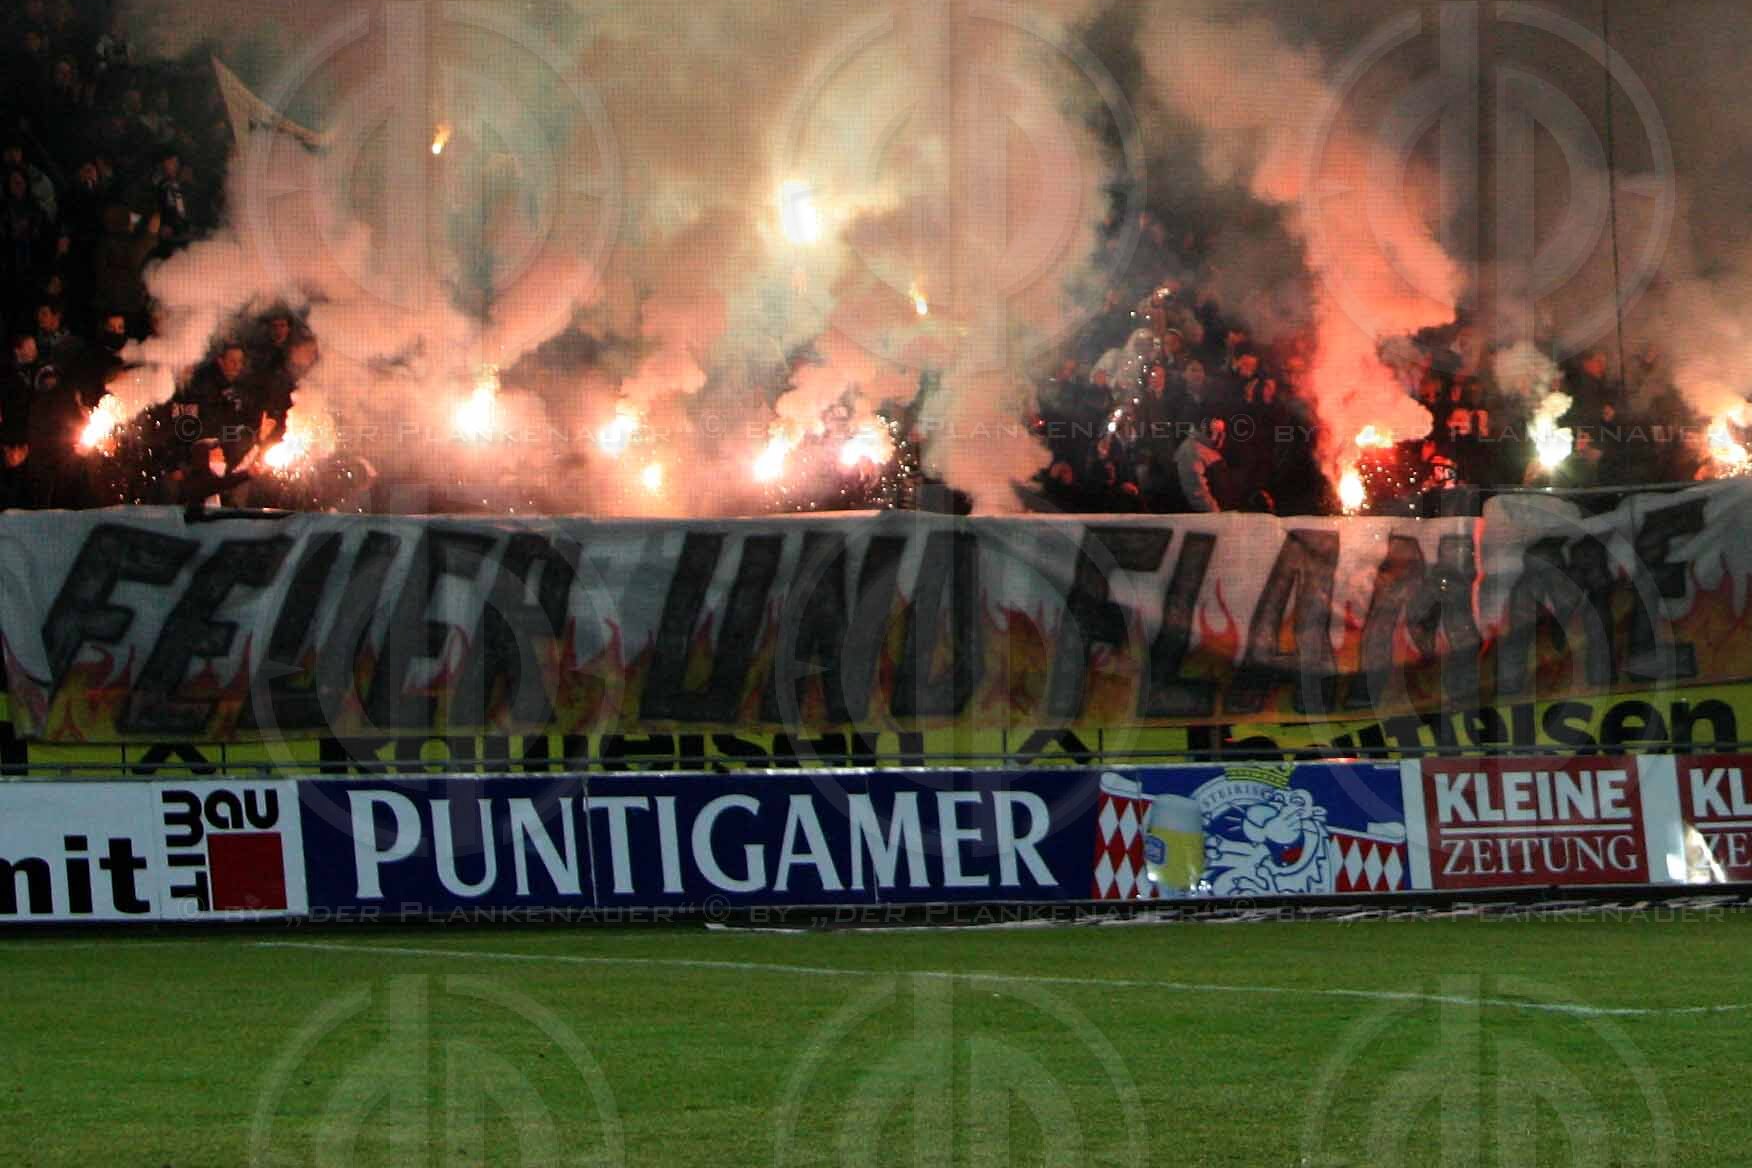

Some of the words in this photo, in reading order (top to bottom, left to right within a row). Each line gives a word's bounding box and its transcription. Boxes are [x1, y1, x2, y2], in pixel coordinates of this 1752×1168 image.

[42, 522, 583, 735] FEUER
[1439, 768, 1633, 824] KLEINE
[347, 788, 1060, 901] PUNTIGAMER
[1441, 830, 1639, 877] ZEITUNG
